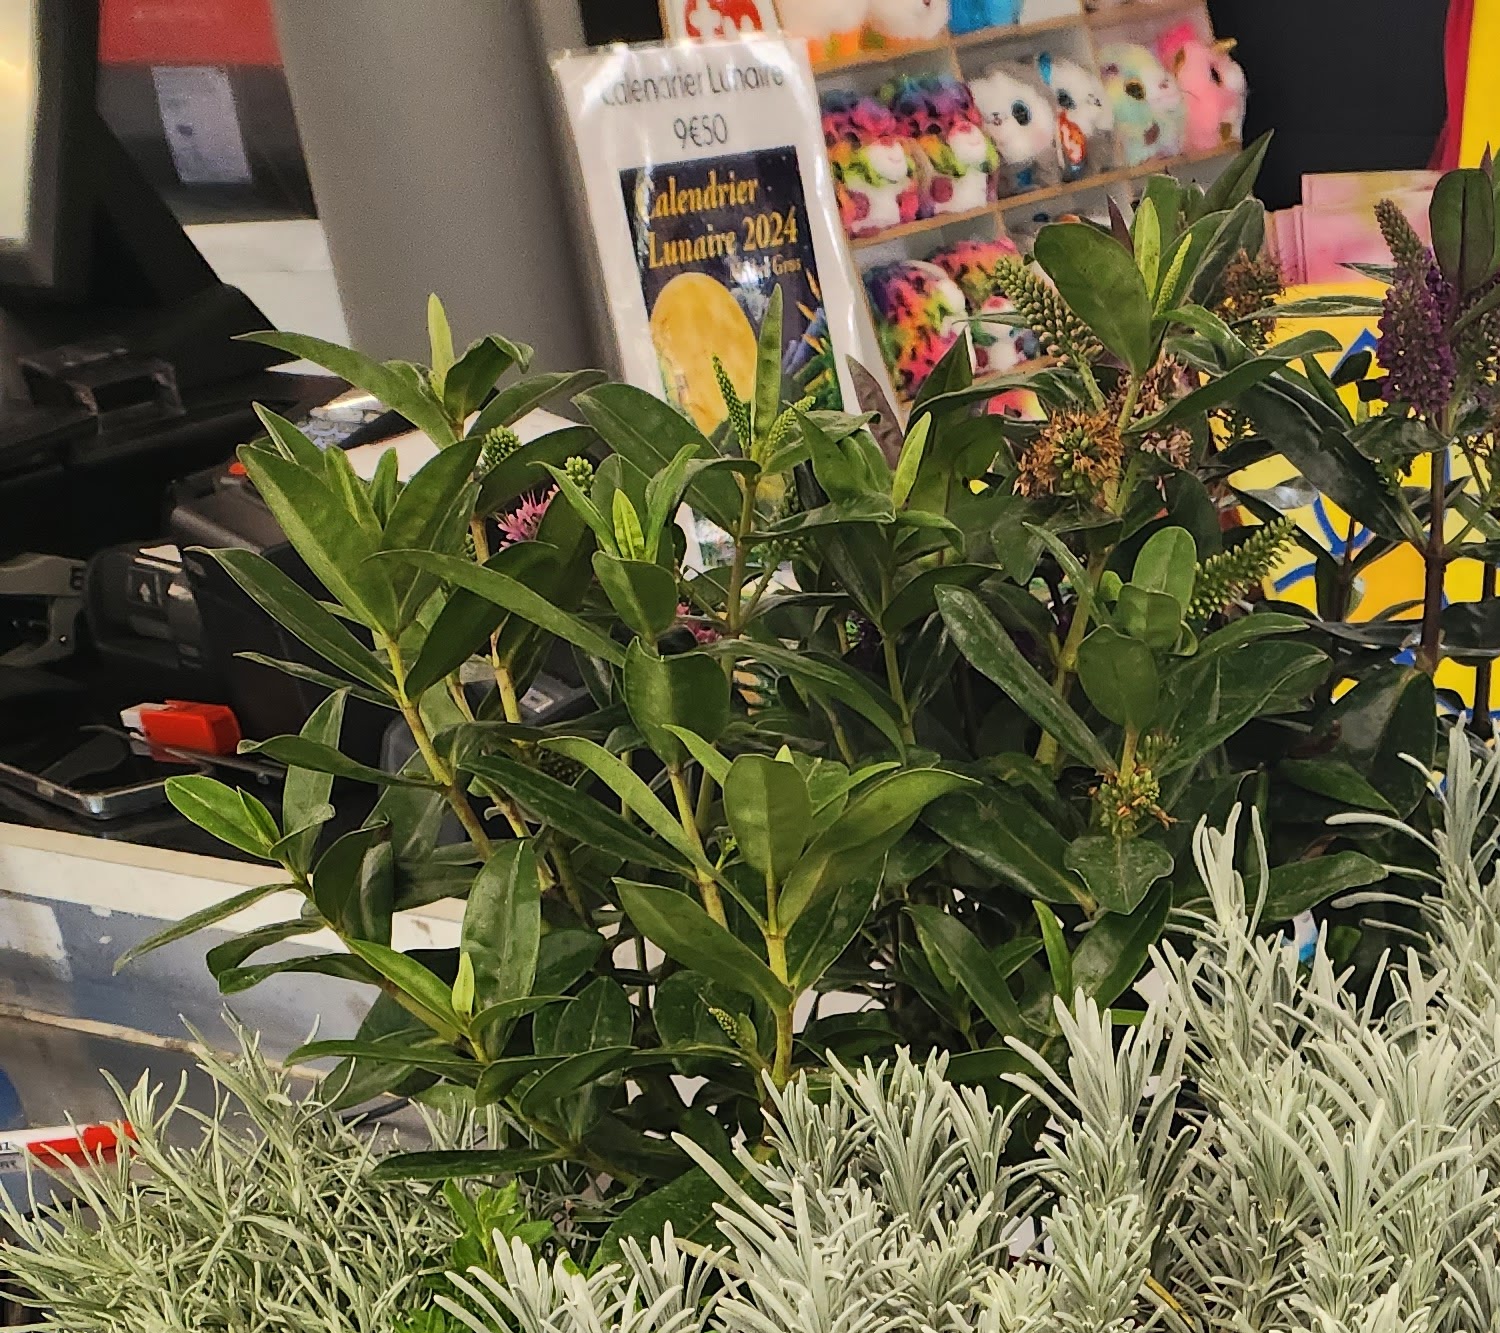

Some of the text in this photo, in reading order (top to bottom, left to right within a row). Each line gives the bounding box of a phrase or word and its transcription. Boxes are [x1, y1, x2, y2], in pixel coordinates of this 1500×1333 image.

[673, 113, 728, 149] 9€50
[636, 169, 758, 219] Calendrier
[649, 224, 737, 269] Lunaire
[742, 206, 799, 252] 2024
